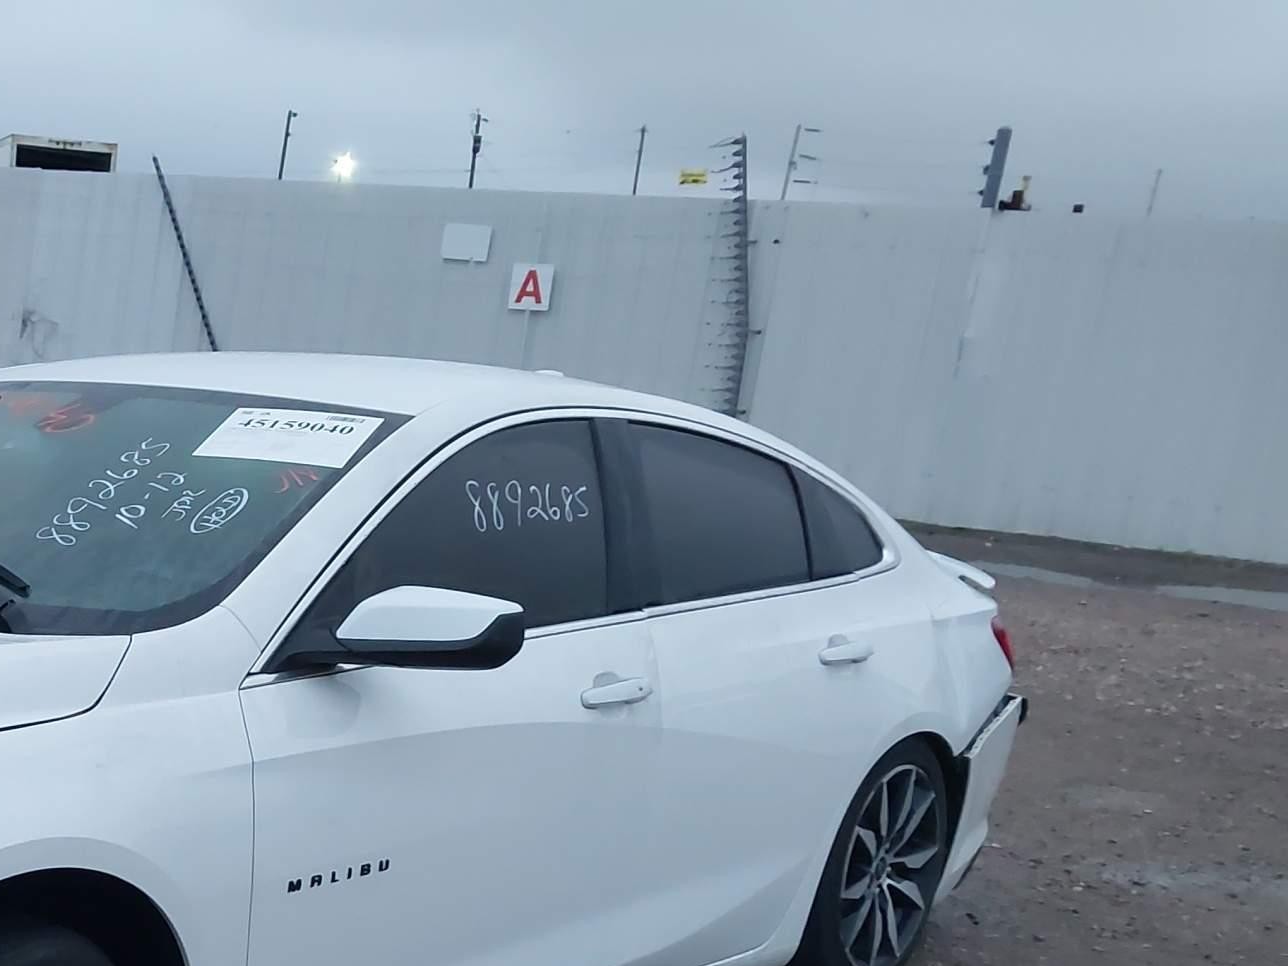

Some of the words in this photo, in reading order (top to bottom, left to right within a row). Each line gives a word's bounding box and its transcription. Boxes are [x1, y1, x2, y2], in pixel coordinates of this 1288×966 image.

[514, 269, 542, 304] A
[239, 418, 355, 435] 45159040
[35, 437, 170, 546] 8892685
[115, 471, 188, 529] 10-12
[465, 480, 590, 532] 8892685
[287, 859, 391, 893] MALIBU
